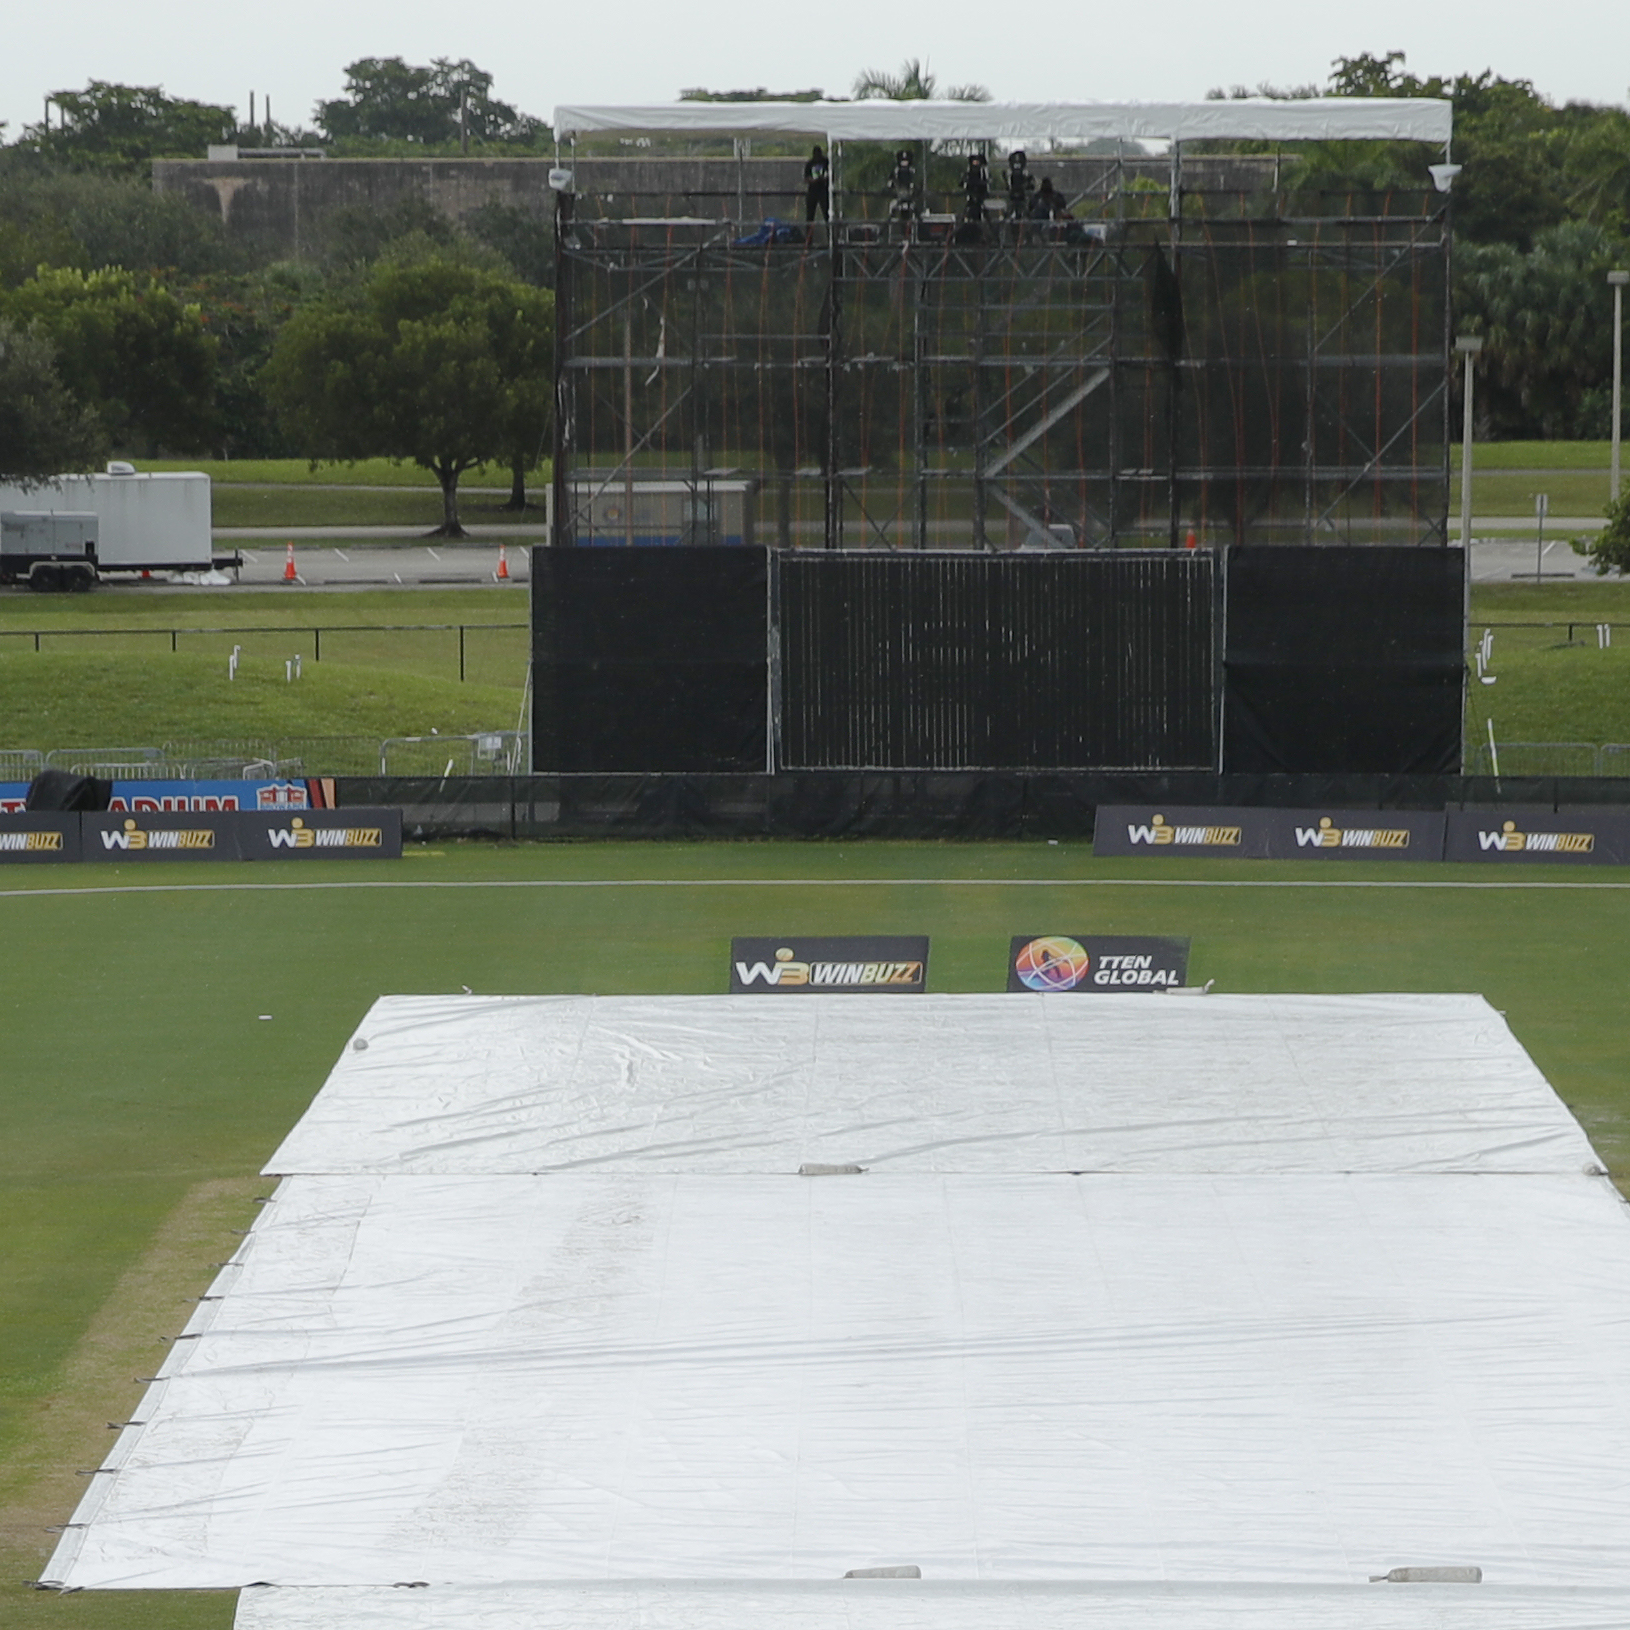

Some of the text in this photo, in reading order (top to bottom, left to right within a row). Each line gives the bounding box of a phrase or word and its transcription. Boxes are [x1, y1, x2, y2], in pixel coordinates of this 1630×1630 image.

[148, 830, 214, 848] WINBUZZ
[316, 829, 380, 848] WINBUZZ
[1174, 827, 1239, 845] WINBUZZ
[1341, 830, 1407, 847] WINBUZZ
[1525, 834, 1593, 851] WINBUZZ
[1099, 955, 1153, 969] TTEN
[813, 963, 920, 984] WINBUZZ
[1094, 969, 1179, 985] GLOBAL
